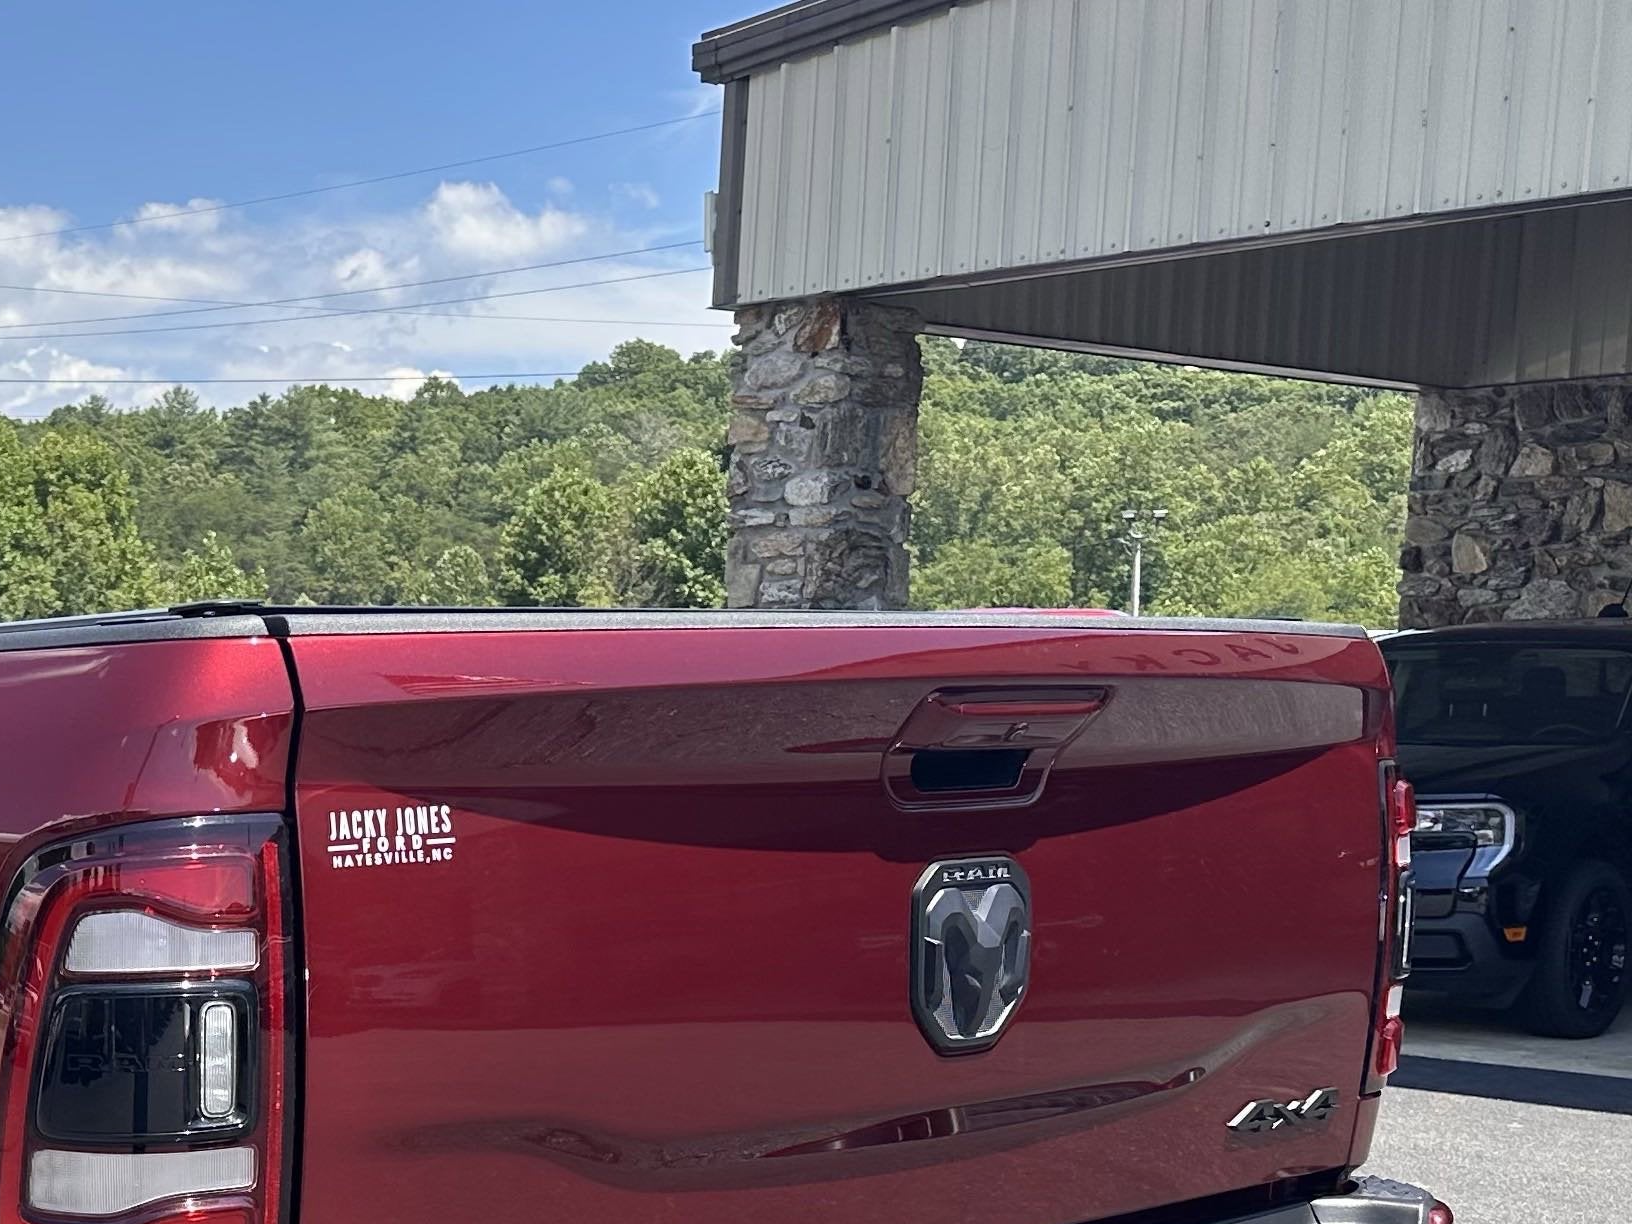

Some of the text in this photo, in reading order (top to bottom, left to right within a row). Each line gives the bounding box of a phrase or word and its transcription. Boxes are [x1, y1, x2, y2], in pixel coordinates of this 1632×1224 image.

[329, 805, 452, 841] JACKY JONES
[362, 834, 423, 853] FORD
[942, 864, 1011, 882] RAM
[67, 1053, 186, 1072] RAM
